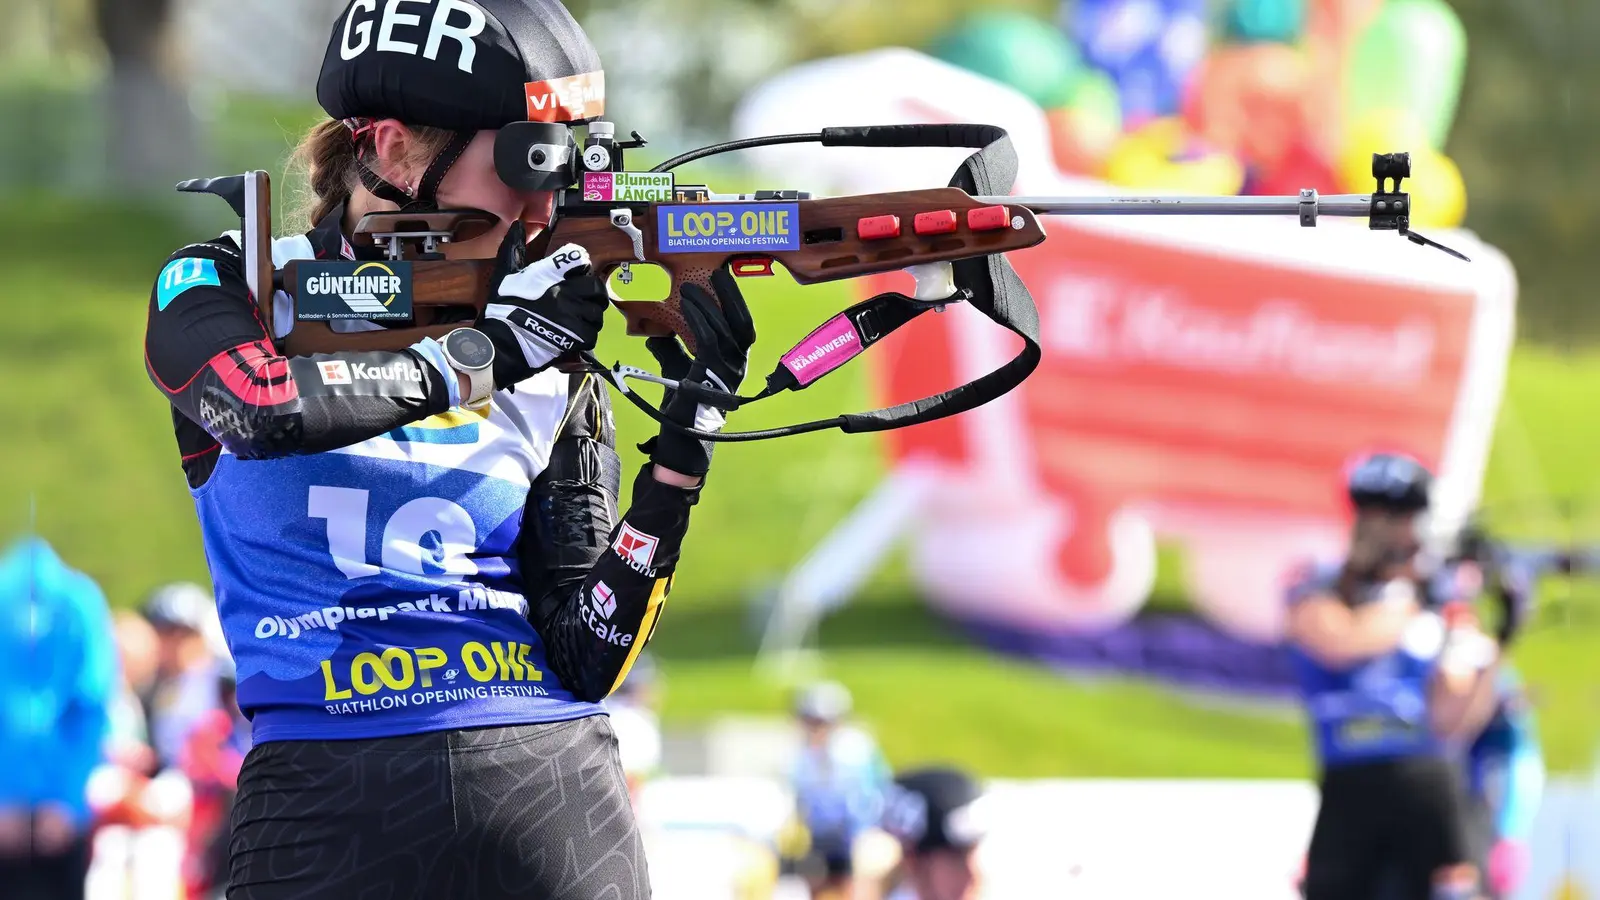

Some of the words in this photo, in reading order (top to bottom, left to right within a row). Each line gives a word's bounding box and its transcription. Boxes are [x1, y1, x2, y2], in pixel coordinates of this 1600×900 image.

[340, 0, 486, 74] GER
[615, 173, 670, 186] Blumen
[615, 186, 671, 201] LÄNGLE
[667, 212, 734, 237] LOOP
[740, 211, 789, 236] ONE
[668, 238, 710, 246] BIATHLON
[711, 237, 751, 246] OPENING
[752, 236, 789, 245] FESTIVAL
[306, 272, 402, 295] GÜNTHNER
[372, 312, 409, 320] guenthner.de
[351, 361, 422, 382] Kaufla
[254, 593, 453, 640] Olympiapark
[320, 647, 448, 701] LOOP
[461, 641, 543, 683] ONE
[325, 694, 408, 716] BIATHLON
[411, 687, 488, 705] OPENING
[490, 684, 549, 698] FESTIVAL
